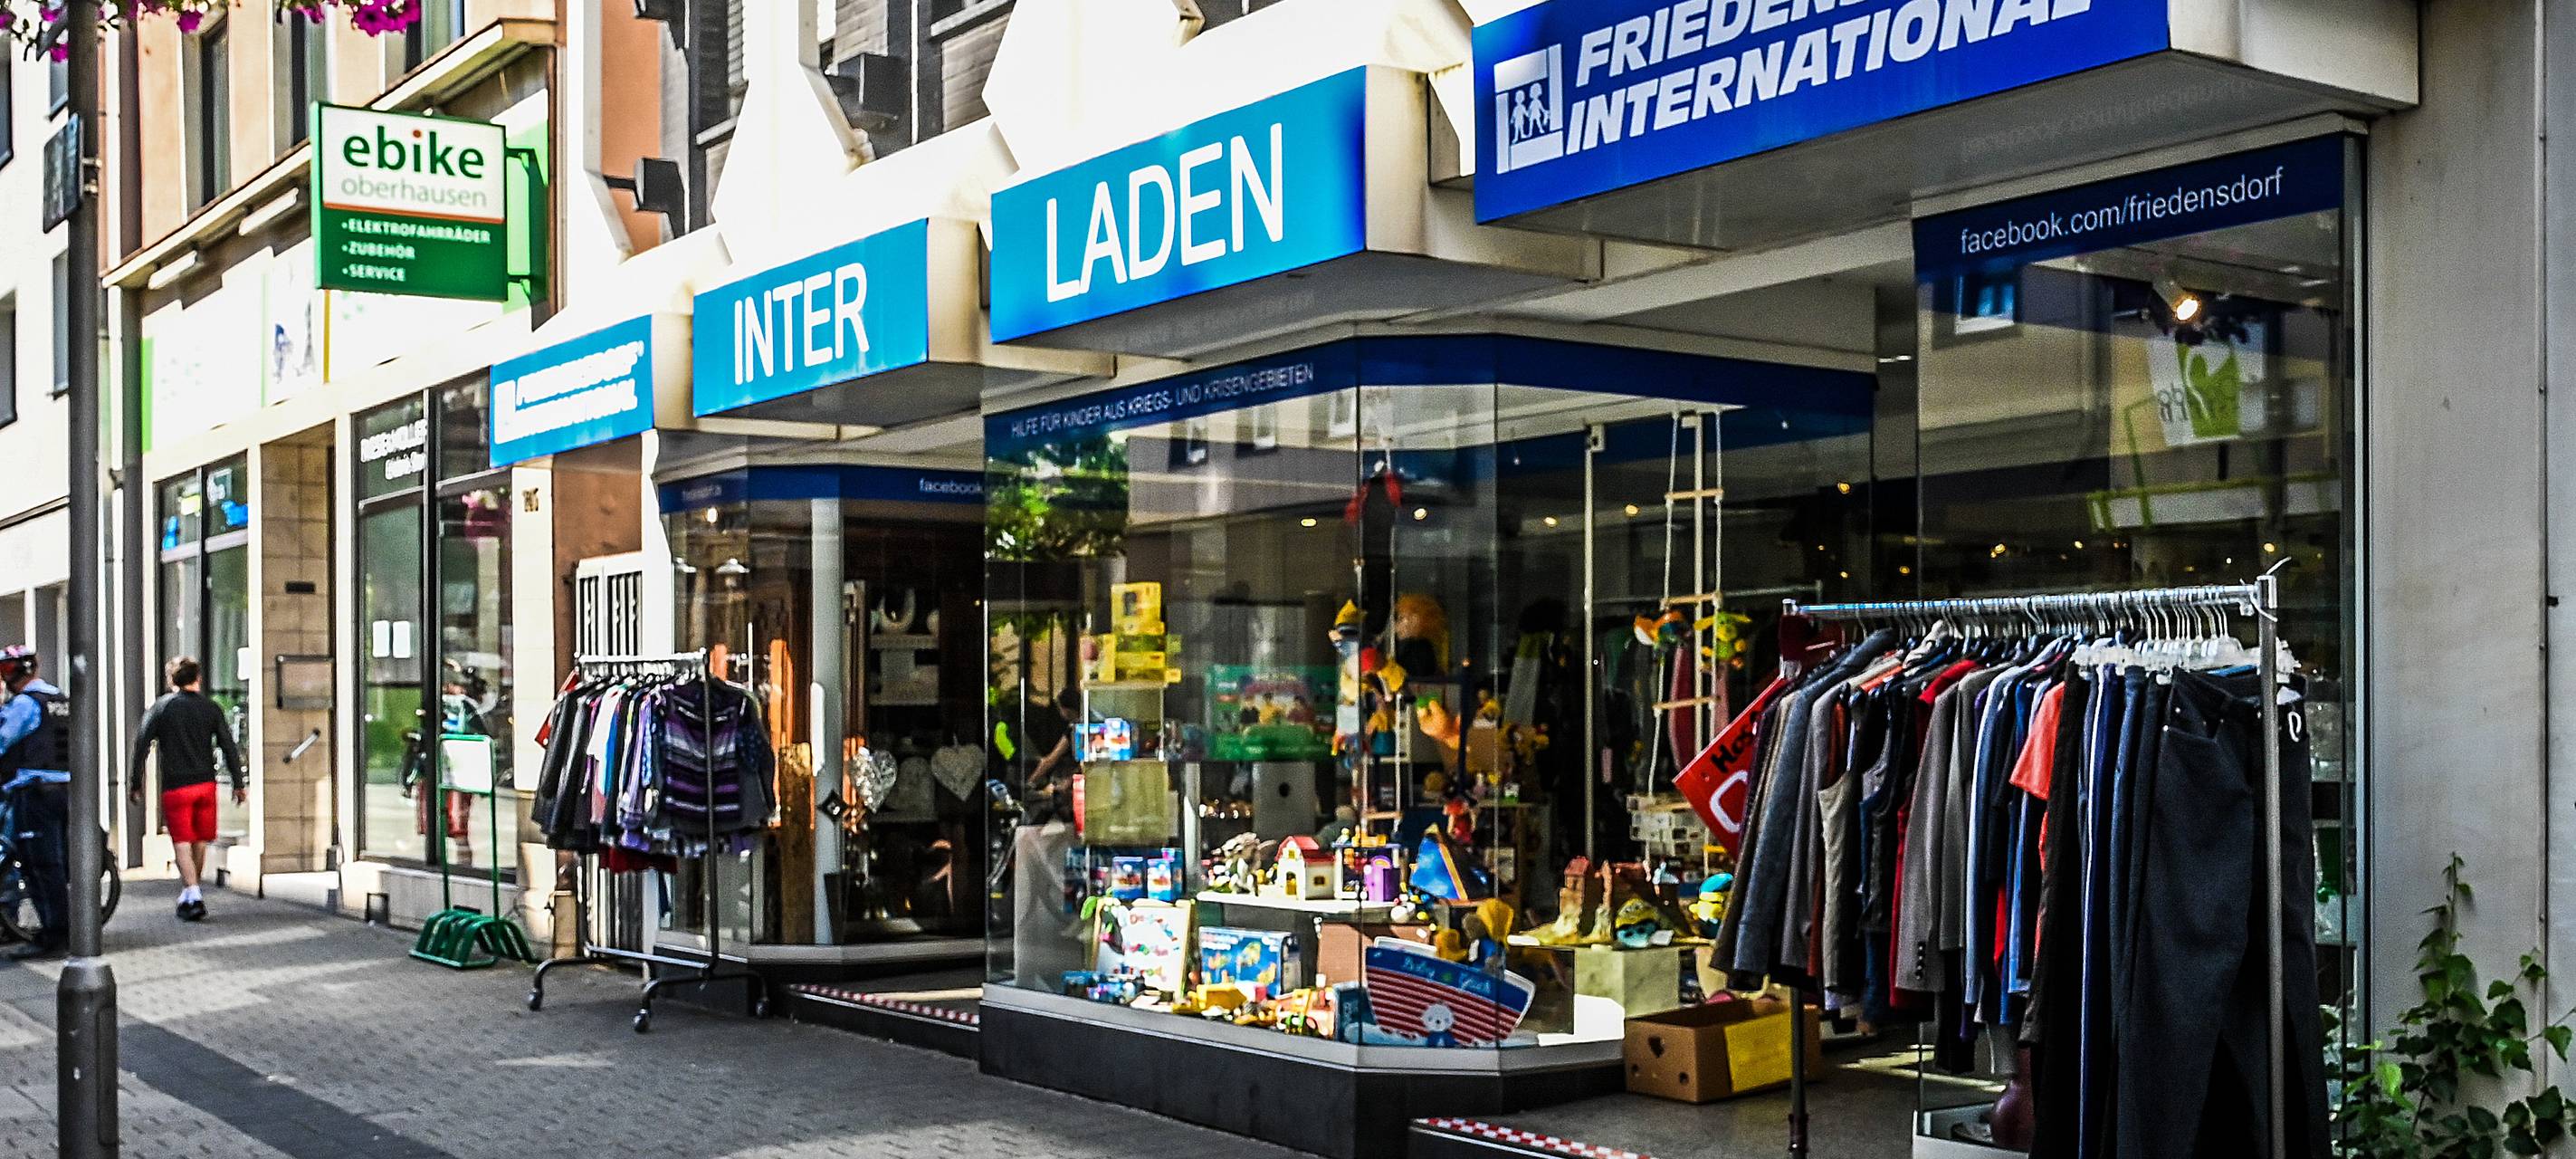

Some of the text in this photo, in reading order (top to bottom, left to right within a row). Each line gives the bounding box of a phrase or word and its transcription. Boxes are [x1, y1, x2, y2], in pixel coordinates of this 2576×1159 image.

[1566, 0, 2092, 155] INTERNATIONA
[343, 125, 484, 178] ebike
[341, 177, 487, 207] oberhausen
[1046, 122, 1283, 302] LADEN
[1961, 166, 2284, 254] facebook.com/friedensdorf
[348, 218, 491, 244] ELEKTROFAHRRÄDER
[348, 241, 415, 260] ZUBEHÖR
[348, 263, 406, 282] SERVICE
[733, 262, 870, 385] INTER
[1011, 363, 1313, 437] HILFE FÜR KINDER AUS KRIEGS- UND KRISENGEBIETEN
